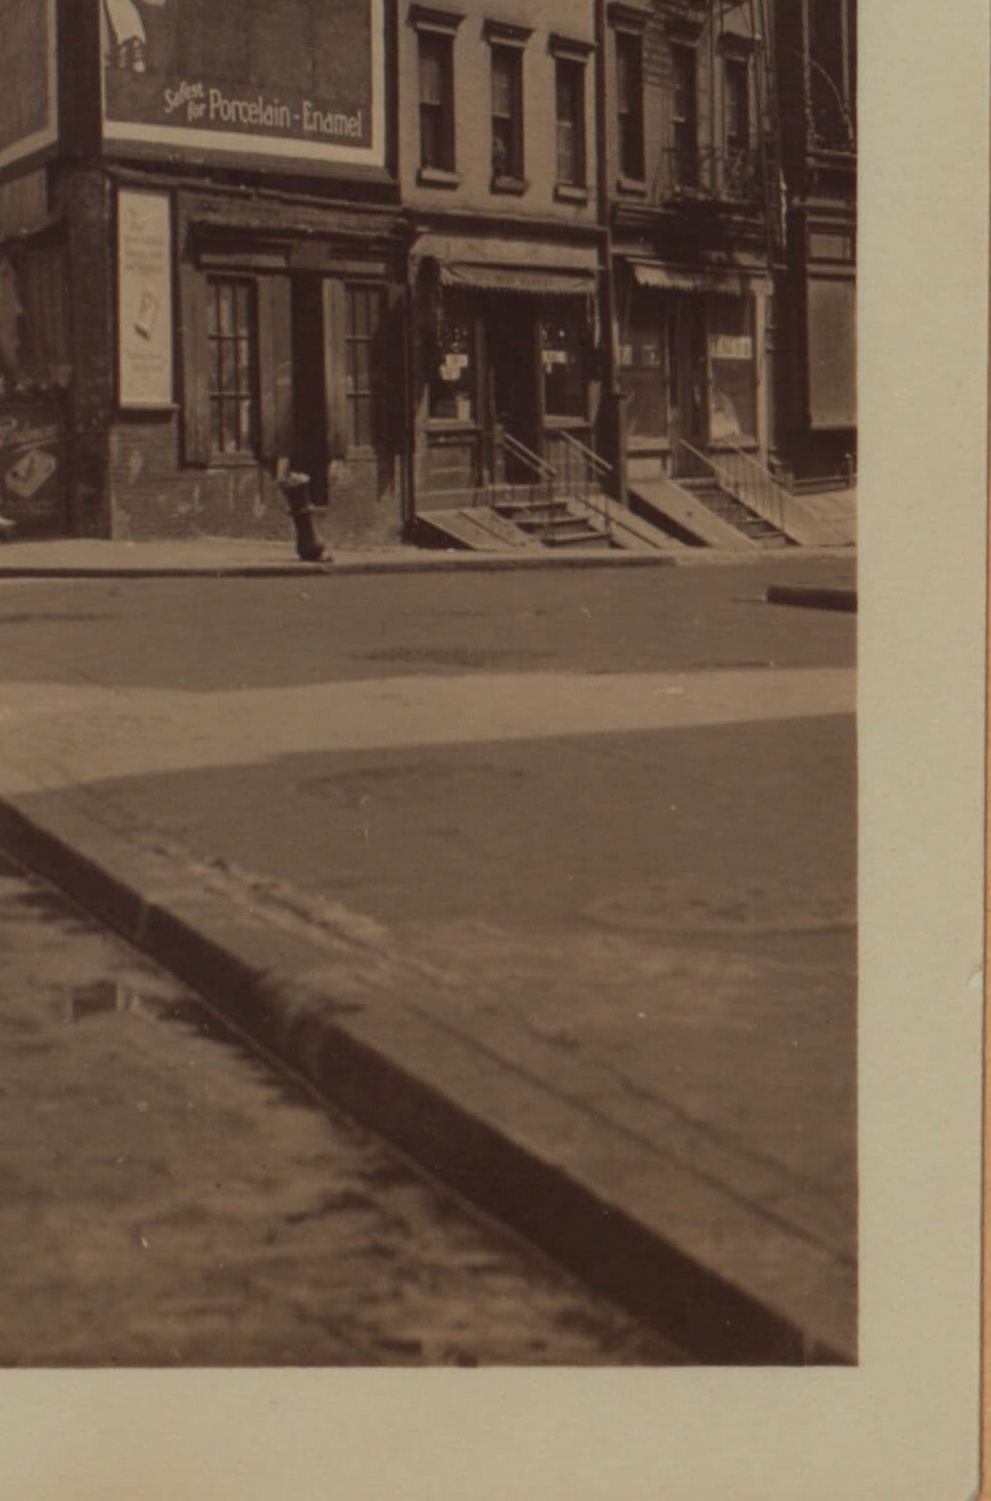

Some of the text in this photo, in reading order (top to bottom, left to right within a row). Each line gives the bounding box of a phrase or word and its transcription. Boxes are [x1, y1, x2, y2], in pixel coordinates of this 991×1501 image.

[187, 99, 207, 122] for
[209, 88, 290, 128] Porcelain
[301, 100, 362, 138] Enamel
